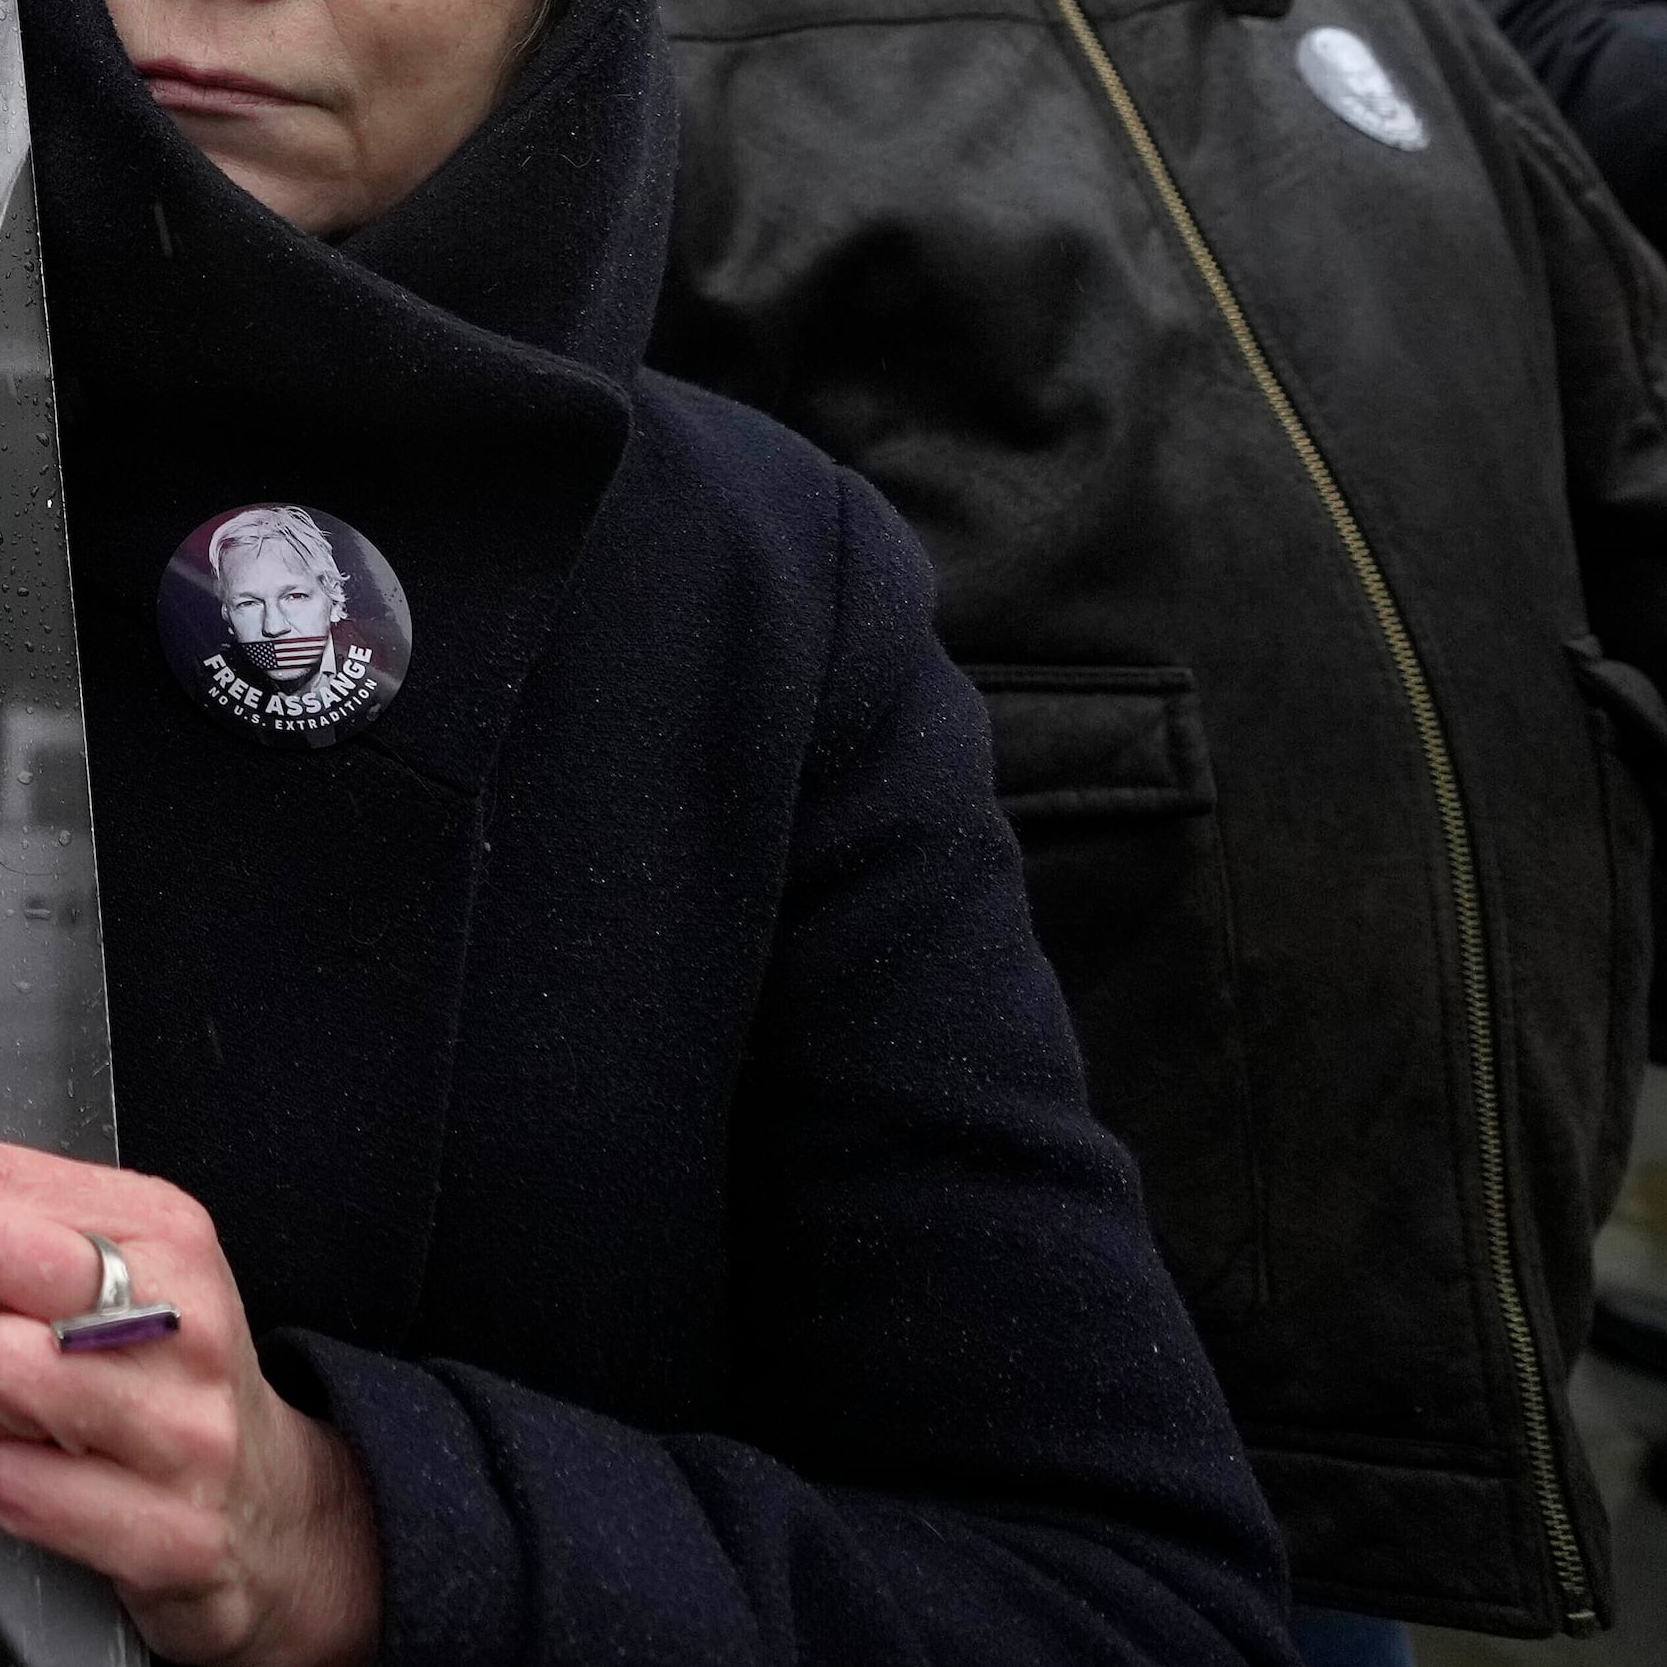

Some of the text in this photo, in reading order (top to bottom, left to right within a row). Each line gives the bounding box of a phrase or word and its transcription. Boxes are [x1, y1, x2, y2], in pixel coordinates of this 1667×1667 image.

[203, 643, 373, 716] FREE ASSANGE
[208, 678, 377, 731] NO U.S. EXTRADITION
